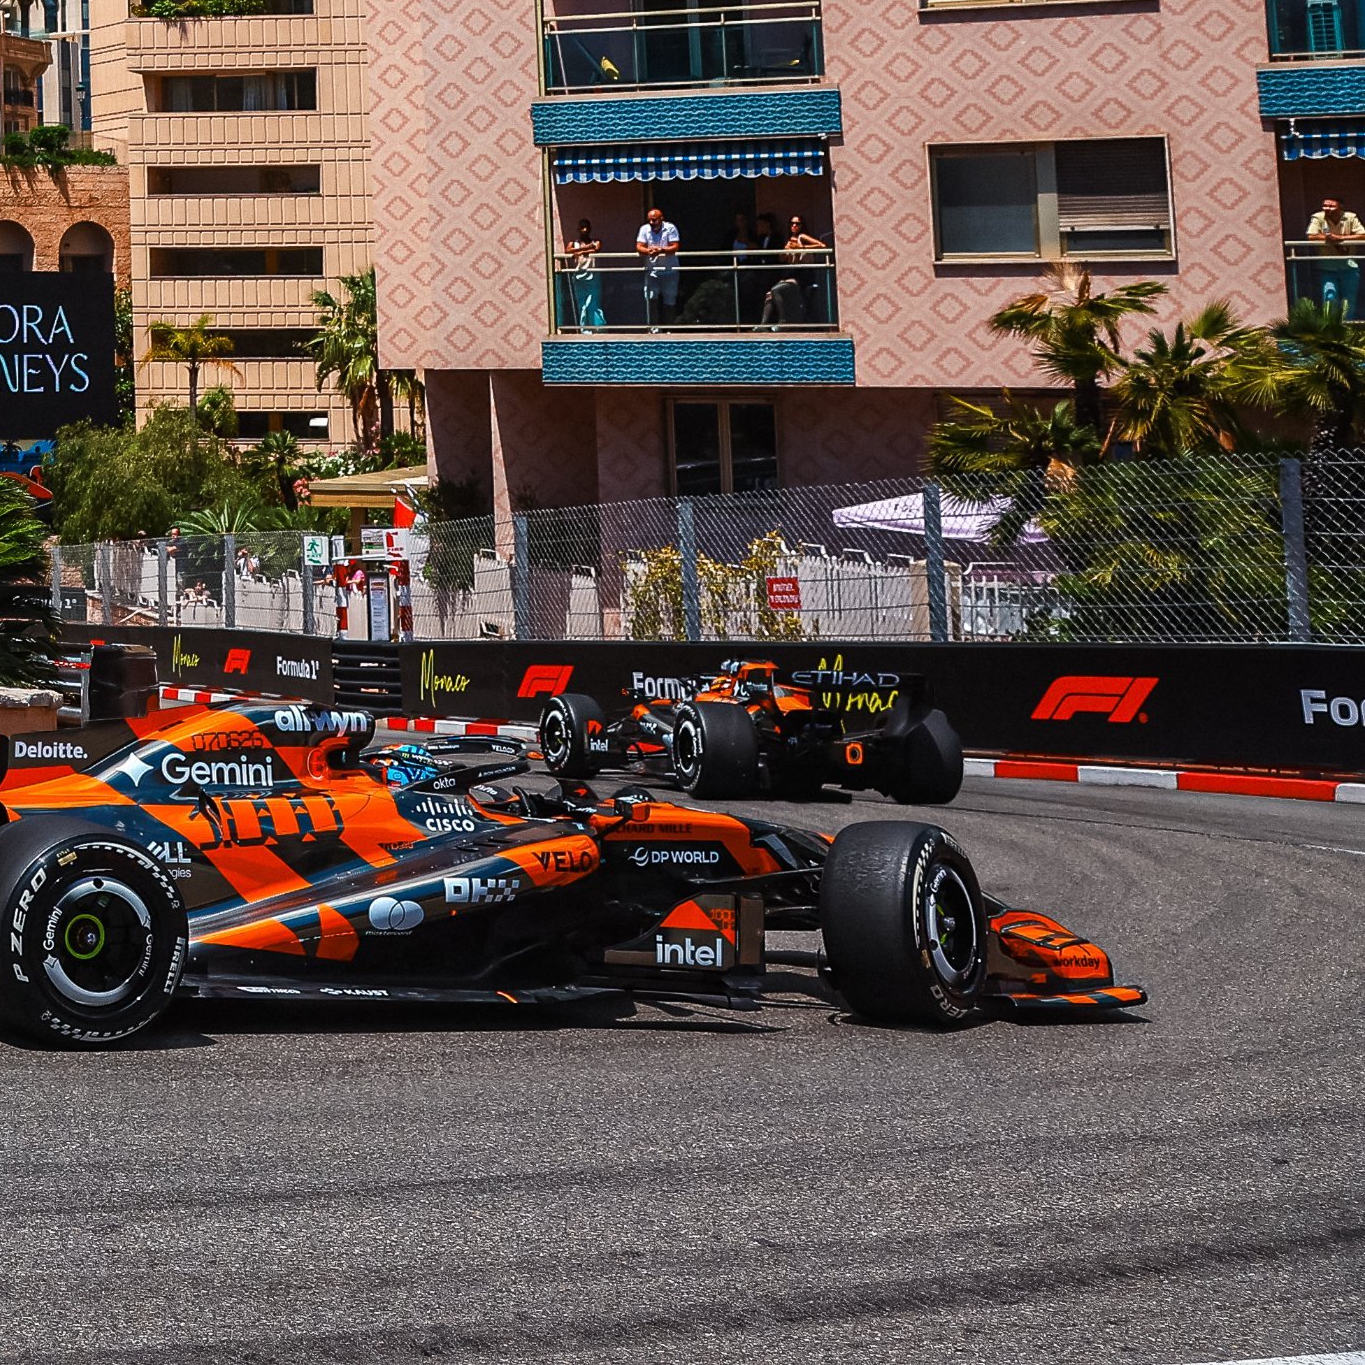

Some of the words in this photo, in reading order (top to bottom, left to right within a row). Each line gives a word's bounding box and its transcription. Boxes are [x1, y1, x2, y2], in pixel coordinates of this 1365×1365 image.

[276, 655, 310, 679] Formula
[419, 647, 470, 708] Monaco
[791, 670, 901, 688] ETIHAD
[274, 704, 368, 738] allwyn
[14, 739, 89, 760] Deloitte.
[589, 737, 609, 752] intel
[161, 752, 274, 787] Gemini
[433, 776, 457, 791] okta
[425, 818, 475, 833] cisco
[658, 822, 693, 834] MILLE
[532, 850, 594, 873] VELO
[651, 850, 670, 864] DP
[671, 850, 720, 864] WORLD
[10, 866, 48, 957] ZERO
[43, 905, 63, 952] Gemini
[656, 935, 723, 967] intel
[1053, 954, 1101, 970] workday
[163, 936, 187, 996] PIRELLI
[343, 987, 389, 997] KAUST
